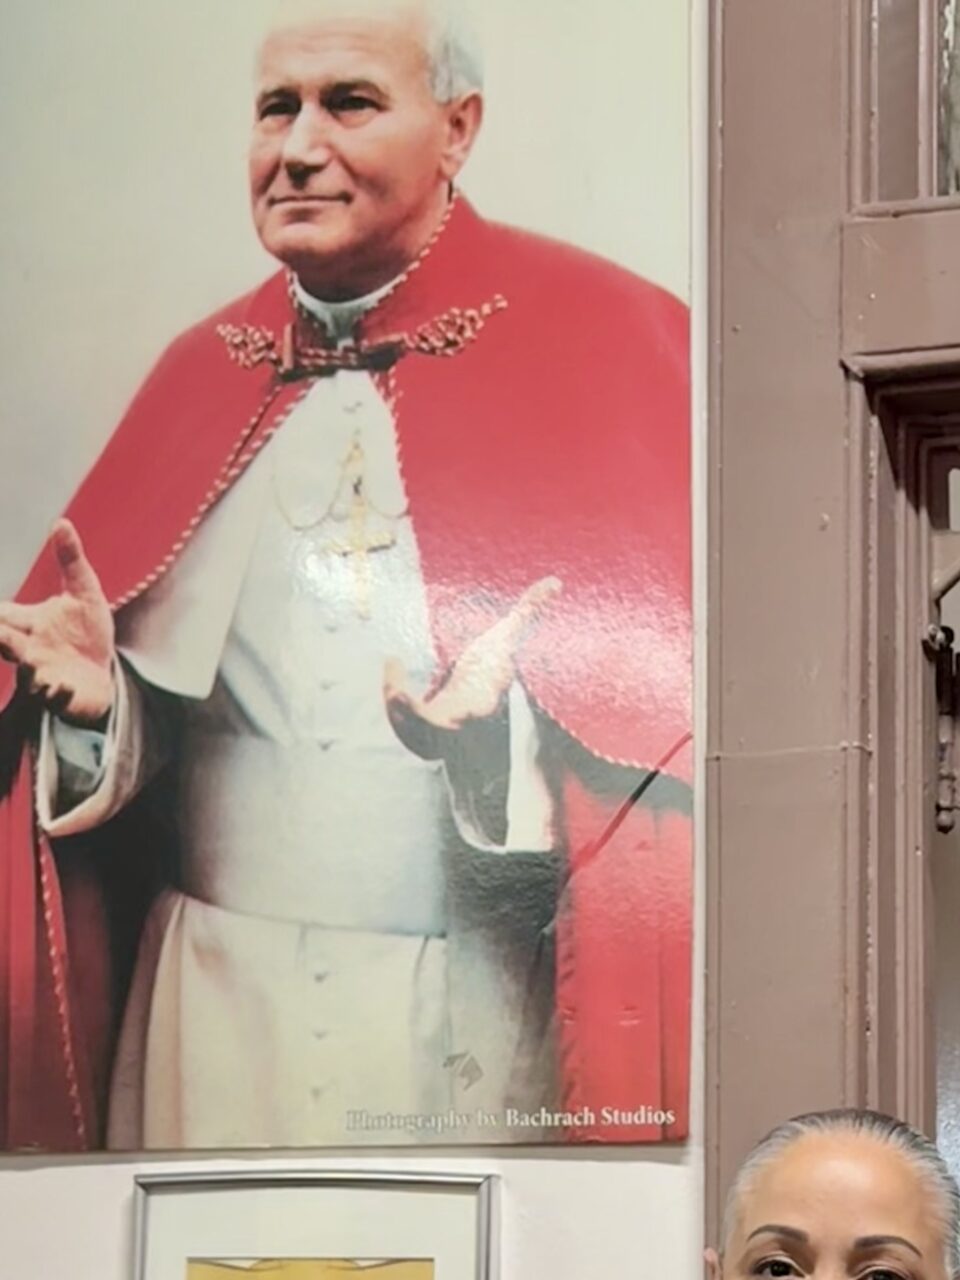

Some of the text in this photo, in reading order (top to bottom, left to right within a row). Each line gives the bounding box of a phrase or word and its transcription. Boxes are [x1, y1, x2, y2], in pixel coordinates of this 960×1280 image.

[346, 1106, 676, 1133] Photography by Bachrach Studios
